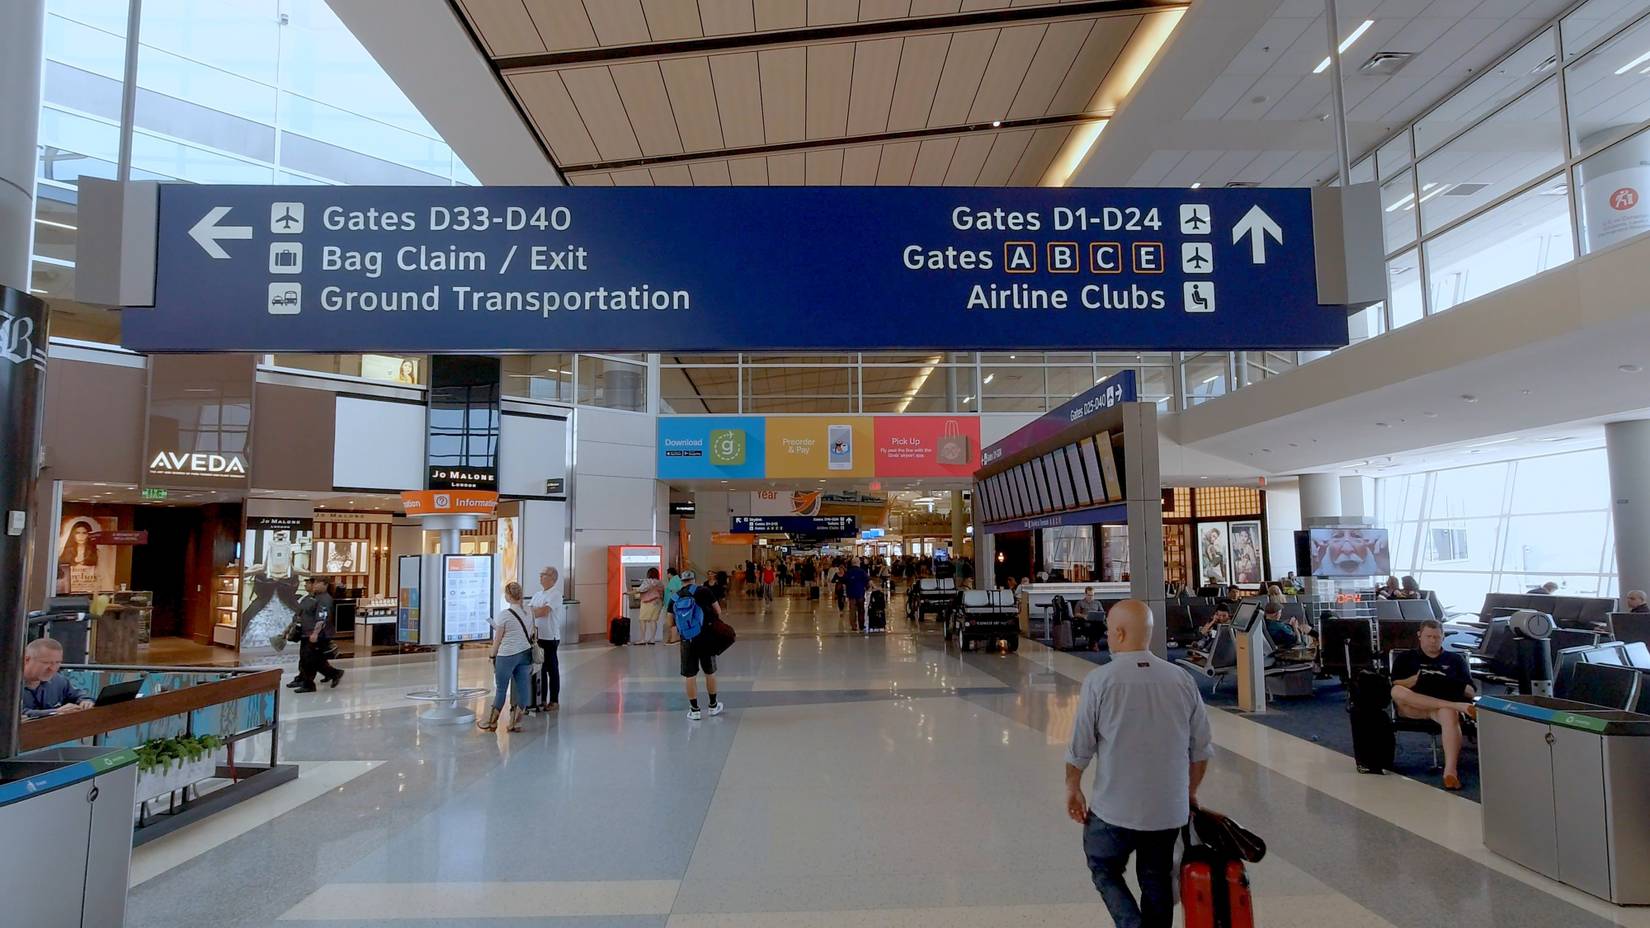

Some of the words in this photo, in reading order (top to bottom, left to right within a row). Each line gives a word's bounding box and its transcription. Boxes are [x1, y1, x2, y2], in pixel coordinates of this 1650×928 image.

[323, 206, 416, 231] Gates
[429, 206, 571, 231] D33-D40
[952, 206, 1041, 231] Gates
[1053, 207, 1162, 231] D1-D24
[322, 246, 383, 278] Bag
[397, 245, 486, 271] Claim
[499, 246, 518, 275] /
[530, 245, 588, 271] Exit
[903, 244, 993, 270] Gates
[1010, 246, 1031, 269] A
[1054, 246, 1072, 269] B
[1096, 246, 1115, 269] C
[1140, 246, 1156, 269] E
[320, 285, 440, 311] Ground
[452, 284, 690, 318] Transportation
[966, 283, 1068, 309] Airline
[1081, 283, 1166, 309] Clubs
[1070, 406, 1084, 422] Gates
[665, 438, 703, 447] Download
[782, 438, 816, 446] Preorder
[796, 446, 811, 454] Pay
[891, 437, 908, 445] Pick
[909, 437, 920, 446] Up
[150, 451, 245, 474] AVEDA
[449, 470, 495, 481] MALONE
